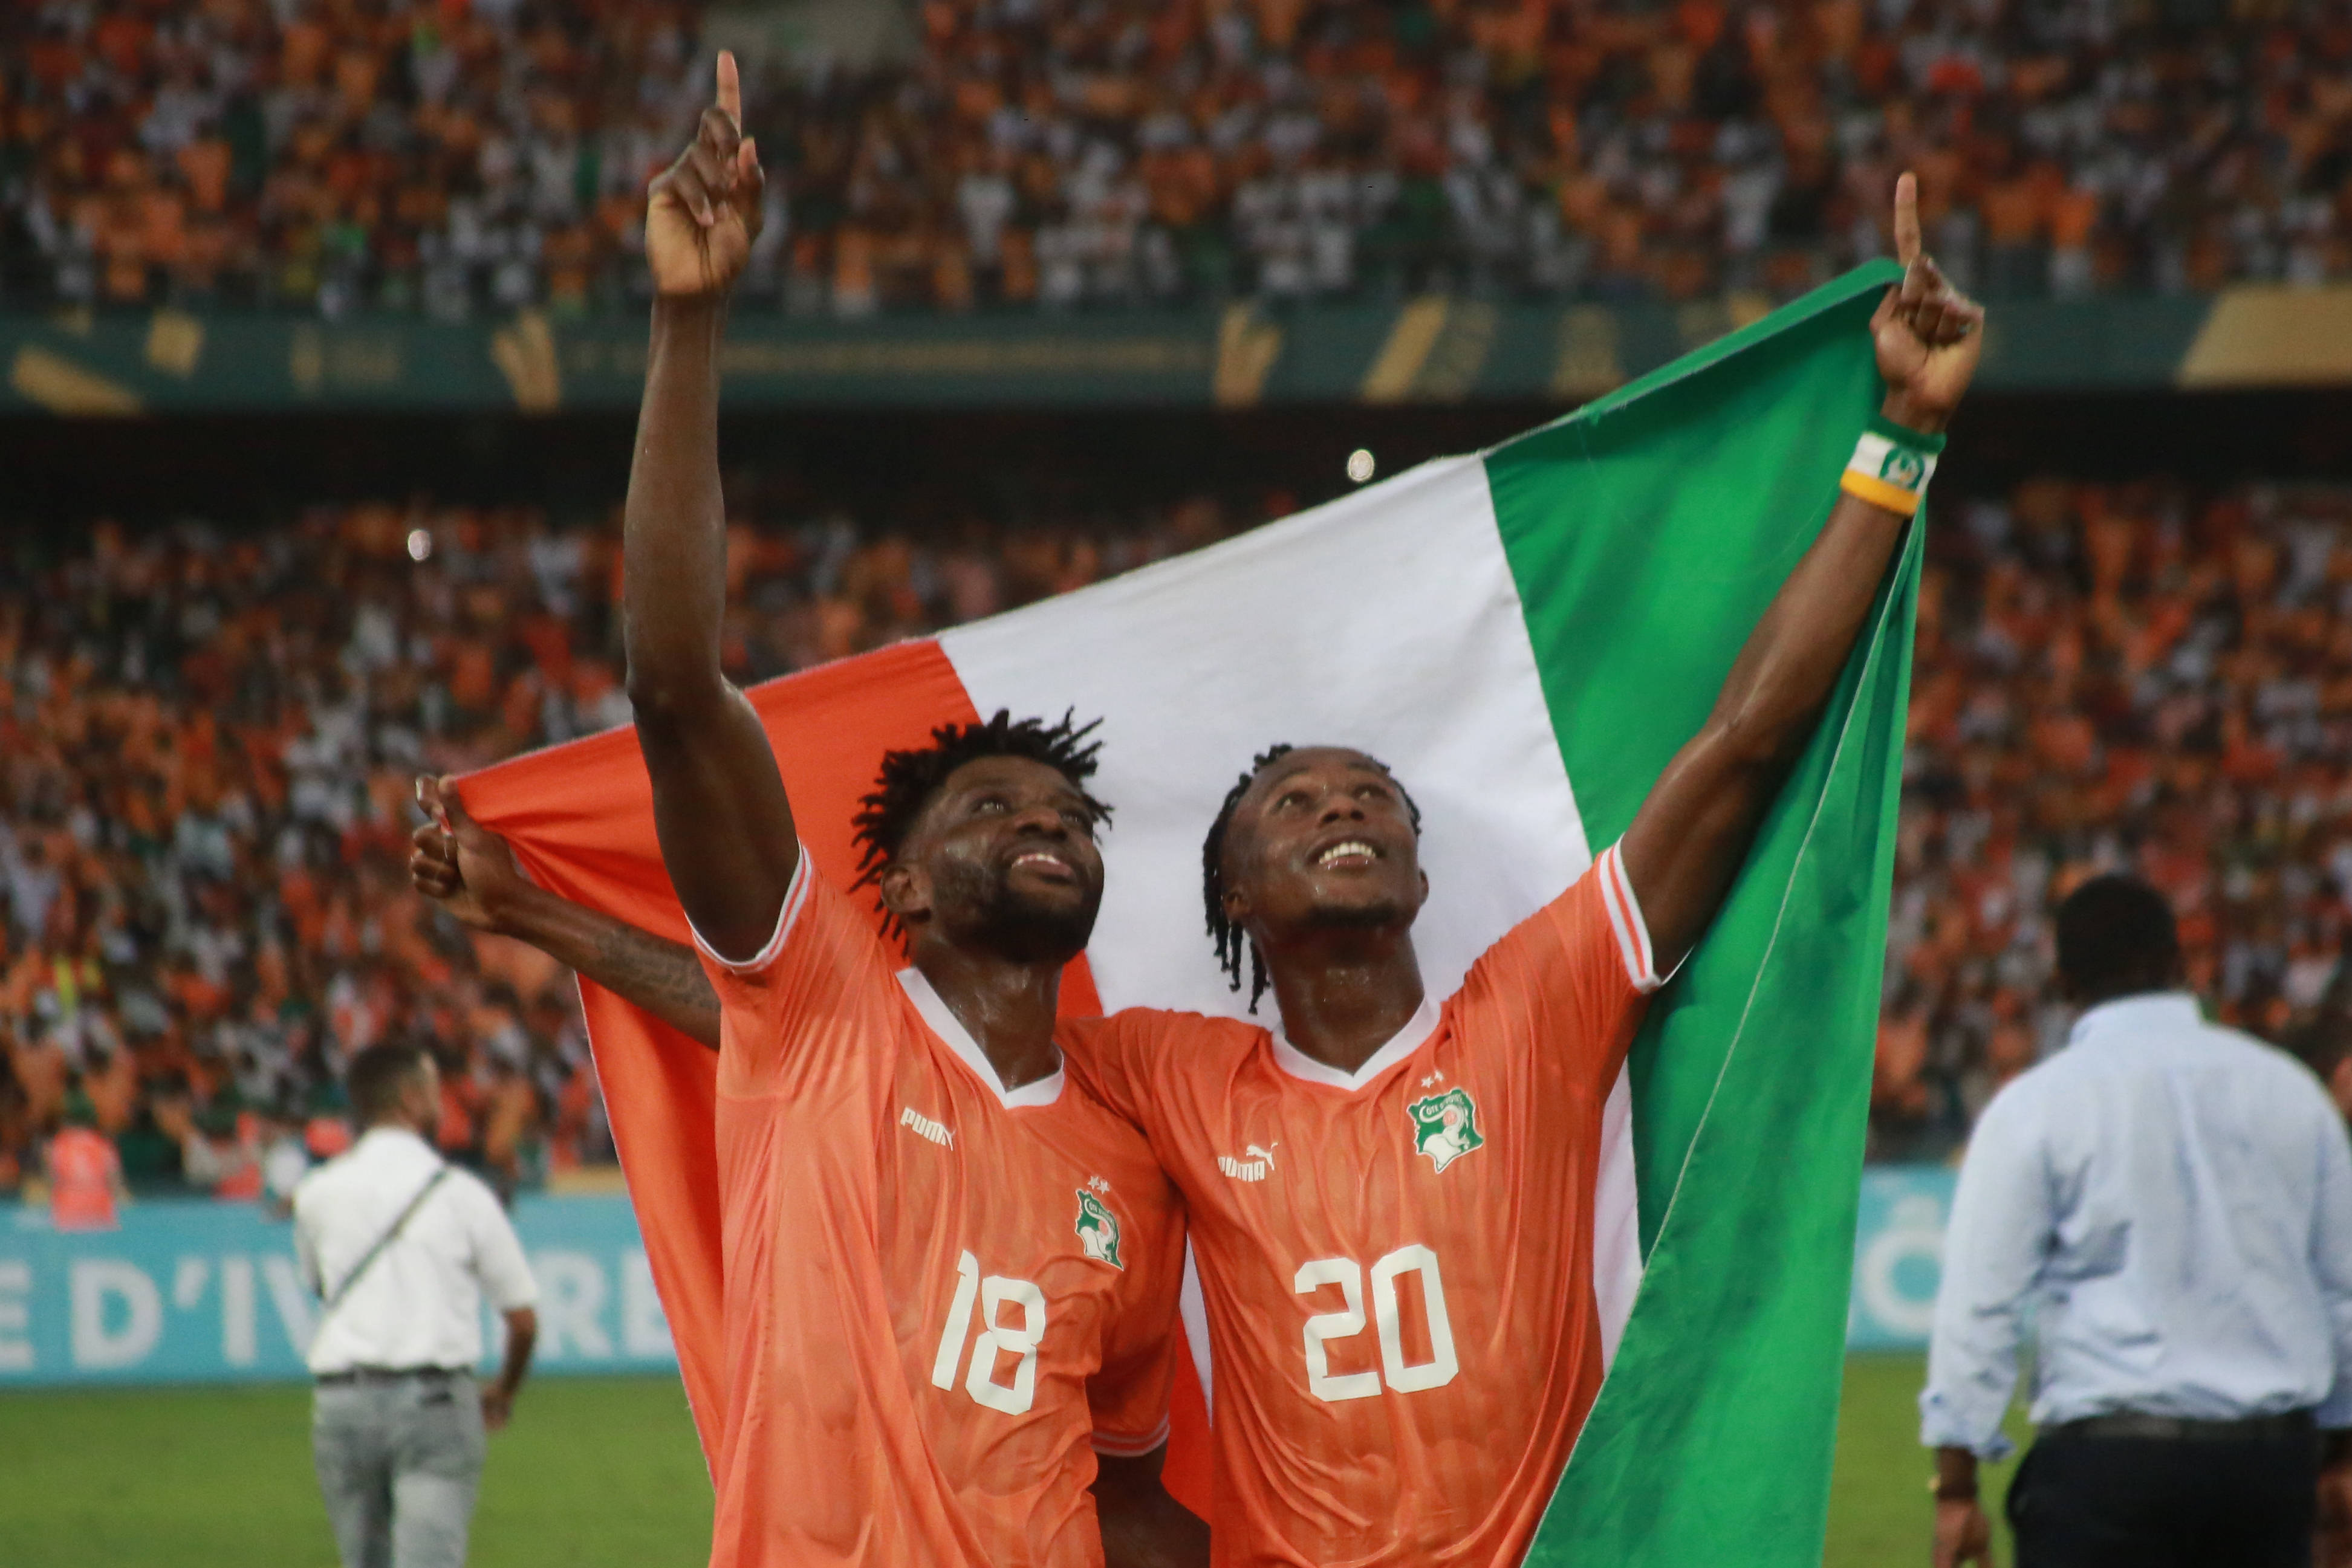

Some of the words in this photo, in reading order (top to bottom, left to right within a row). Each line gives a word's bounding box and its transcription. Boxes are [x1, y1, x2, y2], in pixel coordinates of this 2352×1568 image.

[900, 1107, 947, 1146] PUMA
[932, 1248, 1046, 1416] 18
[1295, 1243, 1459, 1402] 20
